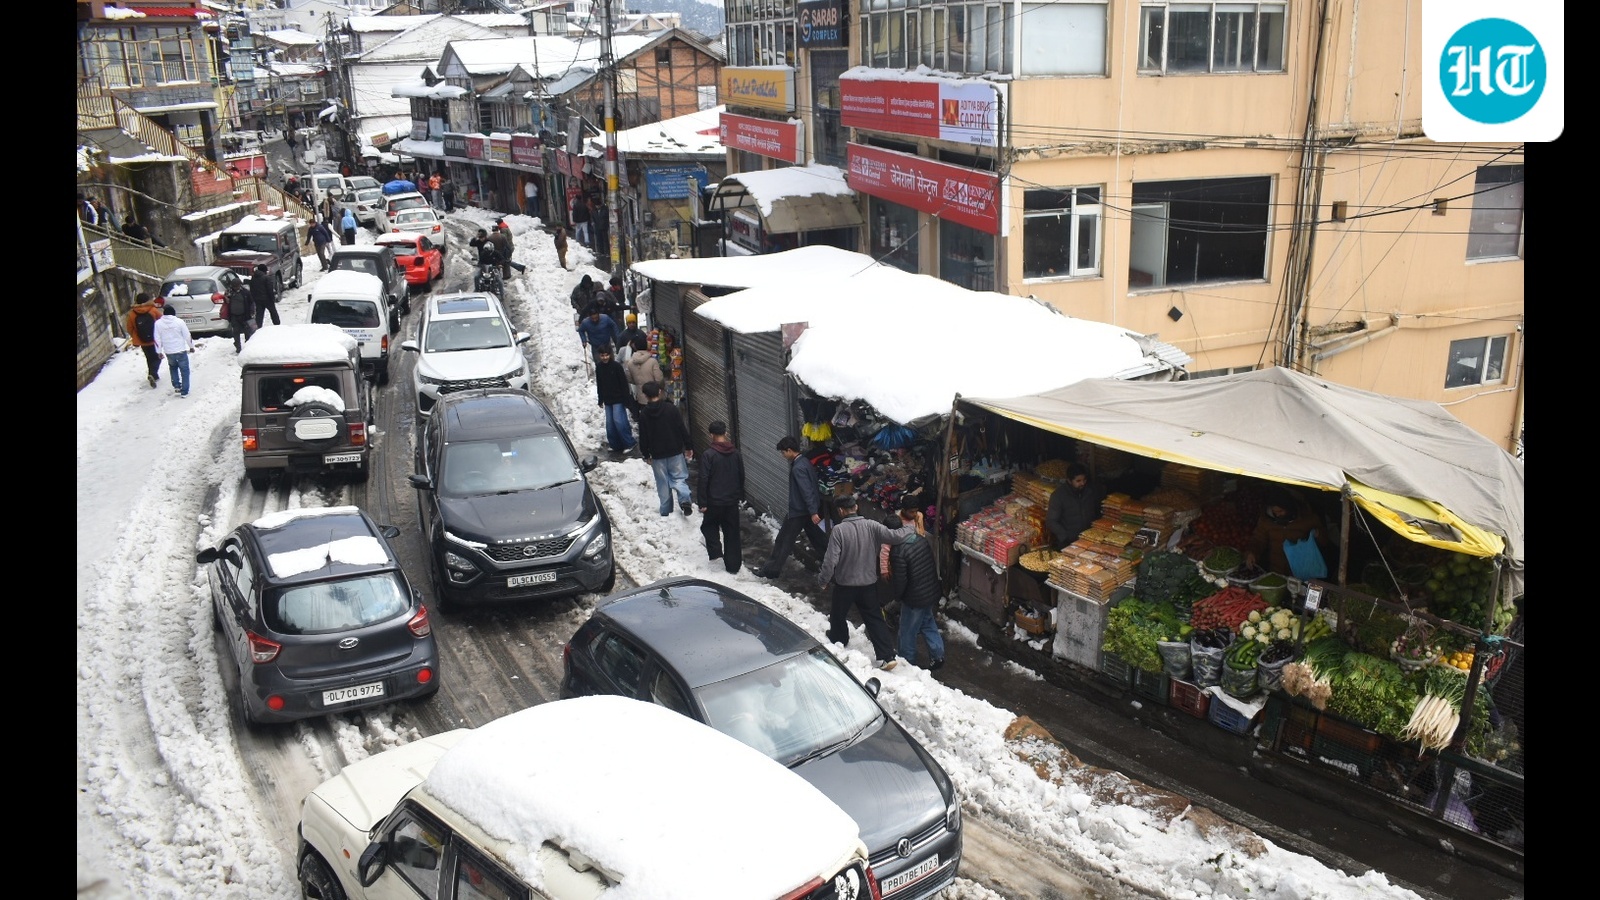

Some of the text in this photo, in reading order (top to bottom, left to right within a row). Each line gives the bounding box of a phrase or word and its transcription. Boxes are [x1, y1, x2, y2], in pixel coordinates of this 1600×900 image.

[812, 8, 837, 27] SARAB
[812, 30, 838, 40] COMPLEX
[960, 100, 990, 111] ADITYA BIRLA
[960, 113, 990, 129] CAPITAL
[890, 163, 915, 191] जेनेराली
[360, 685, 381, 696] 9775
